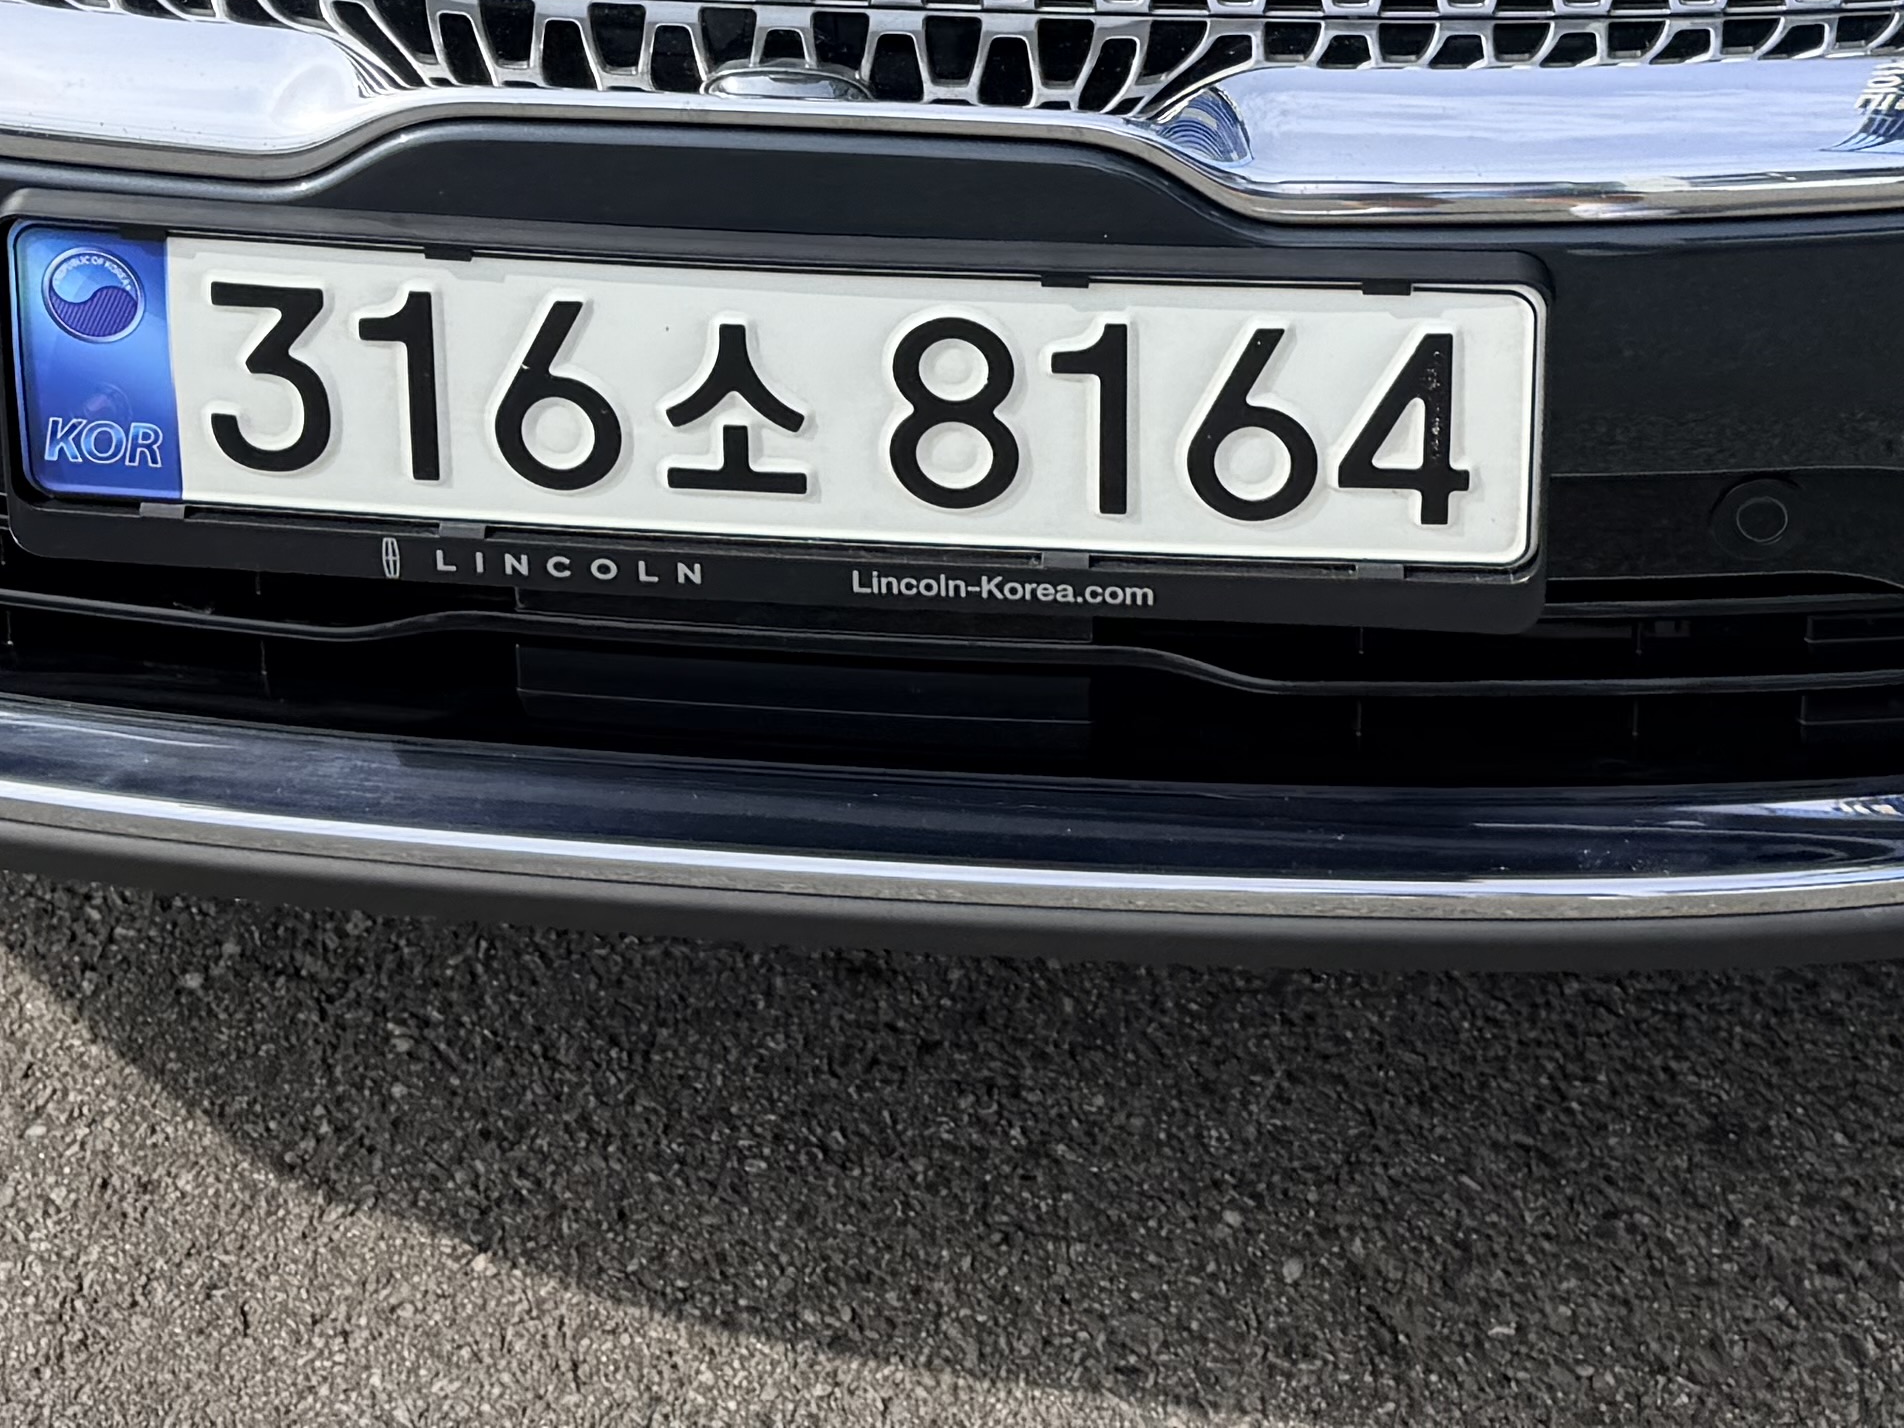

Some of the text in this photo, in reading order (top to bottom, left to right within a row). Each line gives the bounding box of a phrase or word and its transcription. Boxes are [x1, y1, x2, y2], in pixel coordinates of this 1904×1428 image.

[43, 416, 164, 469] KOR
[888, 316, 1470, 525] 8164
[436, 547, 704, 587] LINCOLN
[851, 568, 1156, 608] Lincoln-Korea.com
